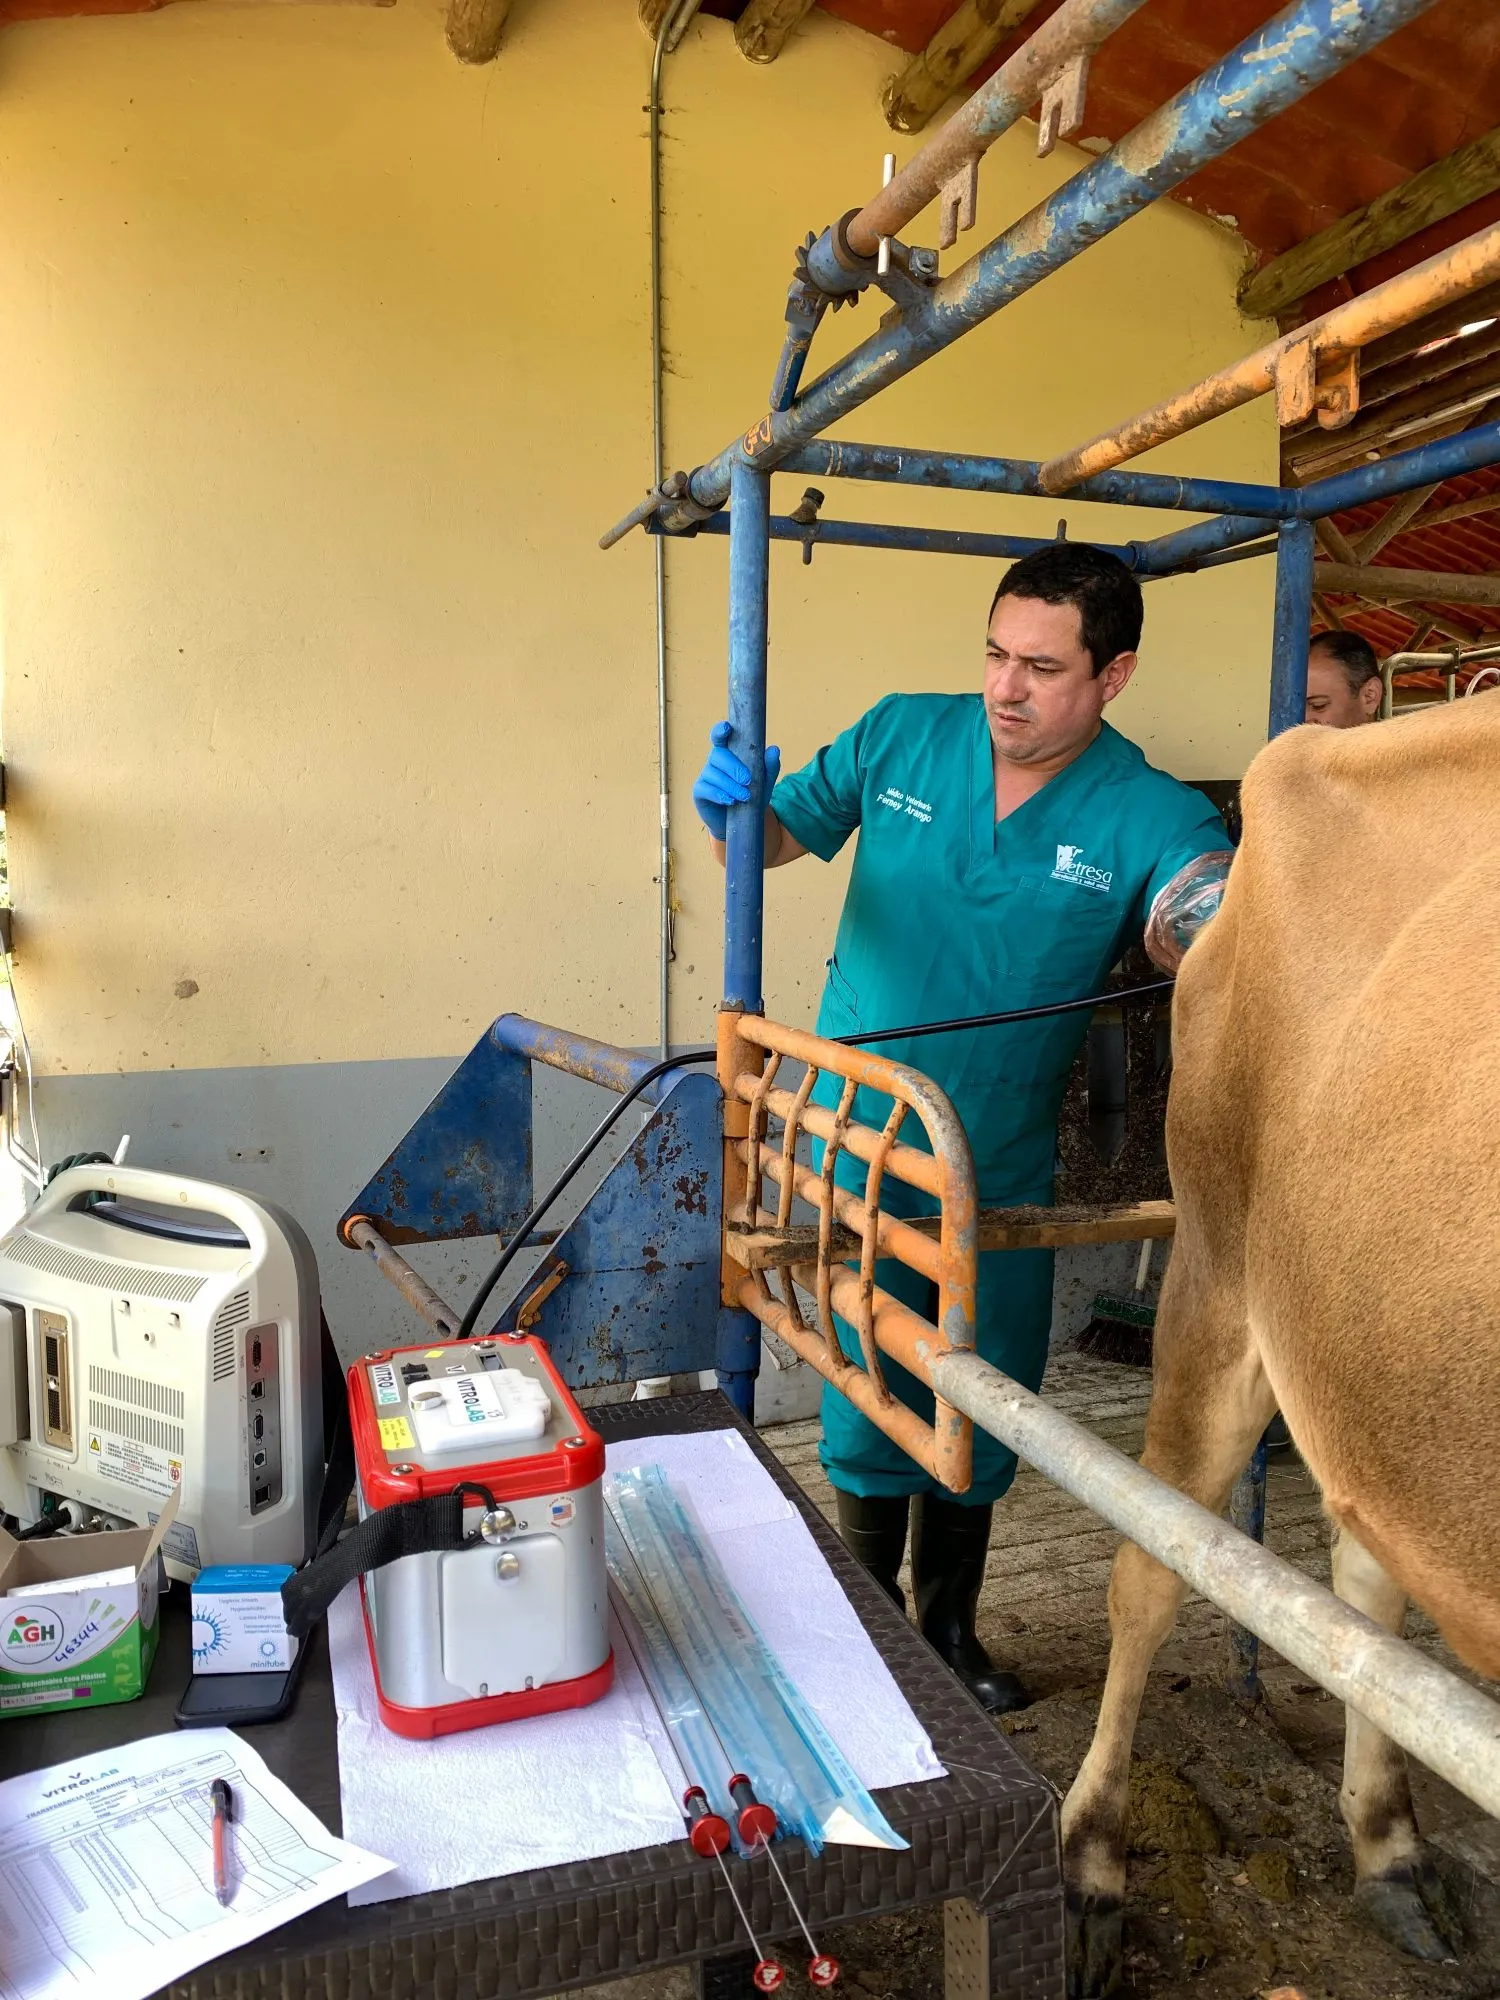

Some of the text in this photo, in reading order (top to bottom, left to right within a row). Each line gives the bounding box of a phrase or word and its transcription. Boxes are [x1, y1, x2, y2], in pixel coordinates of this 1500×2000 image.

[375, 1364, 398, 1403] VITROLAB
[457, 1377, 486, 1422] VITROLAB
[7, 1624, 55, 1645] AGH
[55, 1621, 99, 1663] 46344
[251, 1660, 286, 1669] minitube
[41, 1768, 120, 1799] VITROLAB
